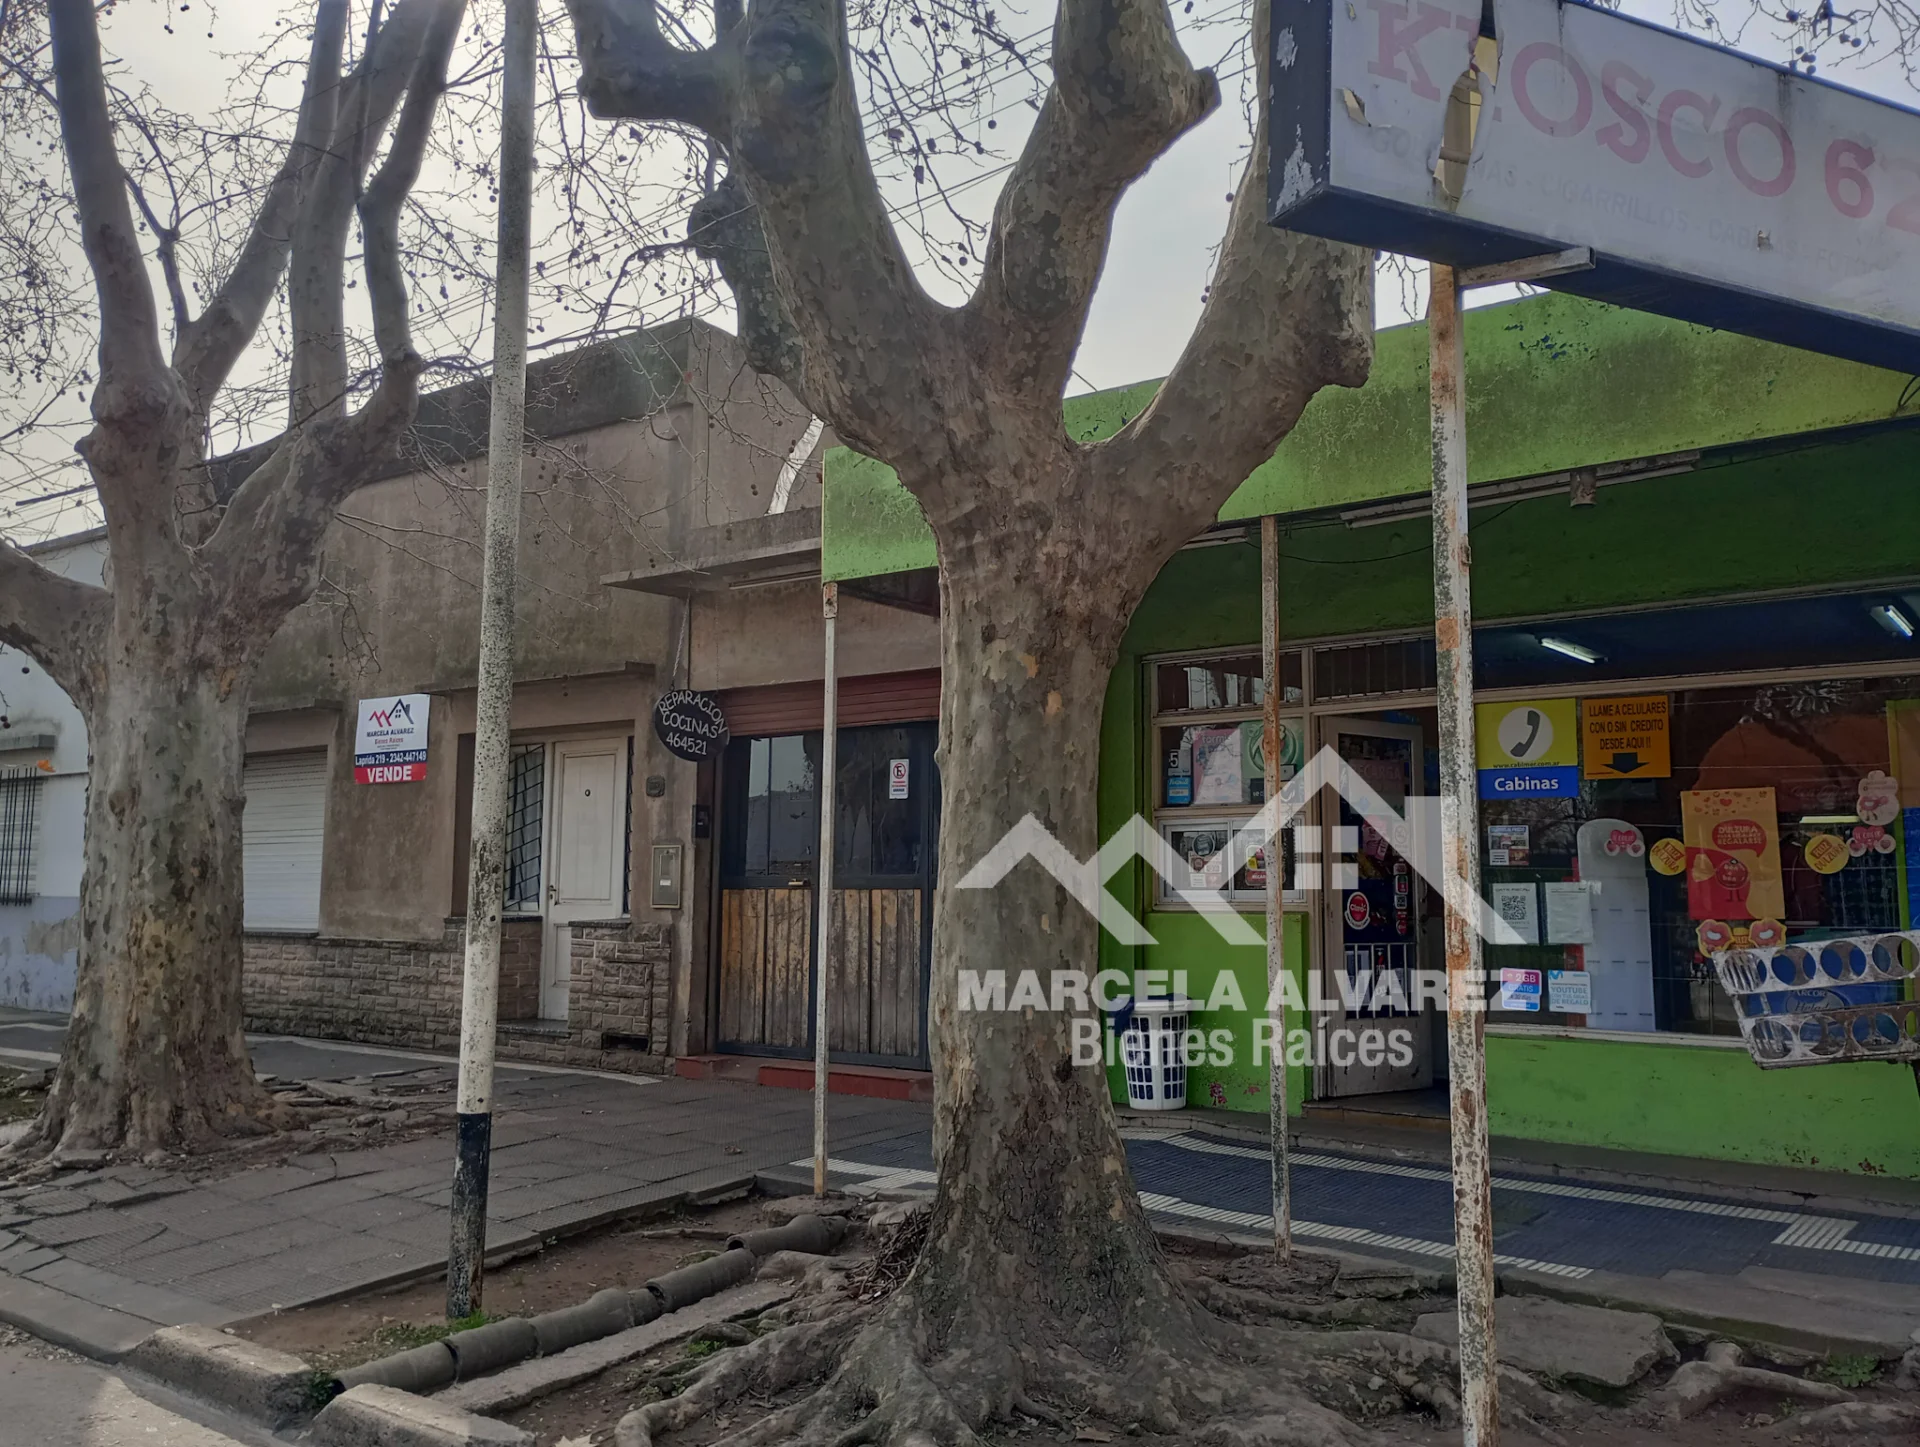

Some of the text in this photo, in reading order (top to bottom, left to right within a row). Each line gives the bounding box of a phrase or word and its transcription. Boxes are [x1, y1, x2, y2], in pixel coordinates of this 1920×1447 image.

[658, 690, 729, 734] REPARACION
[1589, 701, 1667, 717] LLAME A CELULARES
[663, 711, 718, 738] COCINAS
[1589, 718, 1664, 734] CON O SIN CREDITO
[366, 727, 415, 738] MARCELA ALVAREZ
[666, 732, 707, 755] 464521
[1600, 738, 1624, 750] DESDE
[1626, 737, 1644, 749] AQUI
[355, 755, 375, 767] Laprida
[375, 754, 386, 764] 219
[389, 750, 427, 763] 2342-447149
[366, 766, 413, 783] VENDE
[1493, 776, 1560, 791] Cabinas
[1718, 825, 1758, 834] DULZURA
[1515, 974, 1537, 983] 2GB
[1508, 984, 1534, 992] GRATIS
[1551, 986, 1589, 994] YOUTUBE
